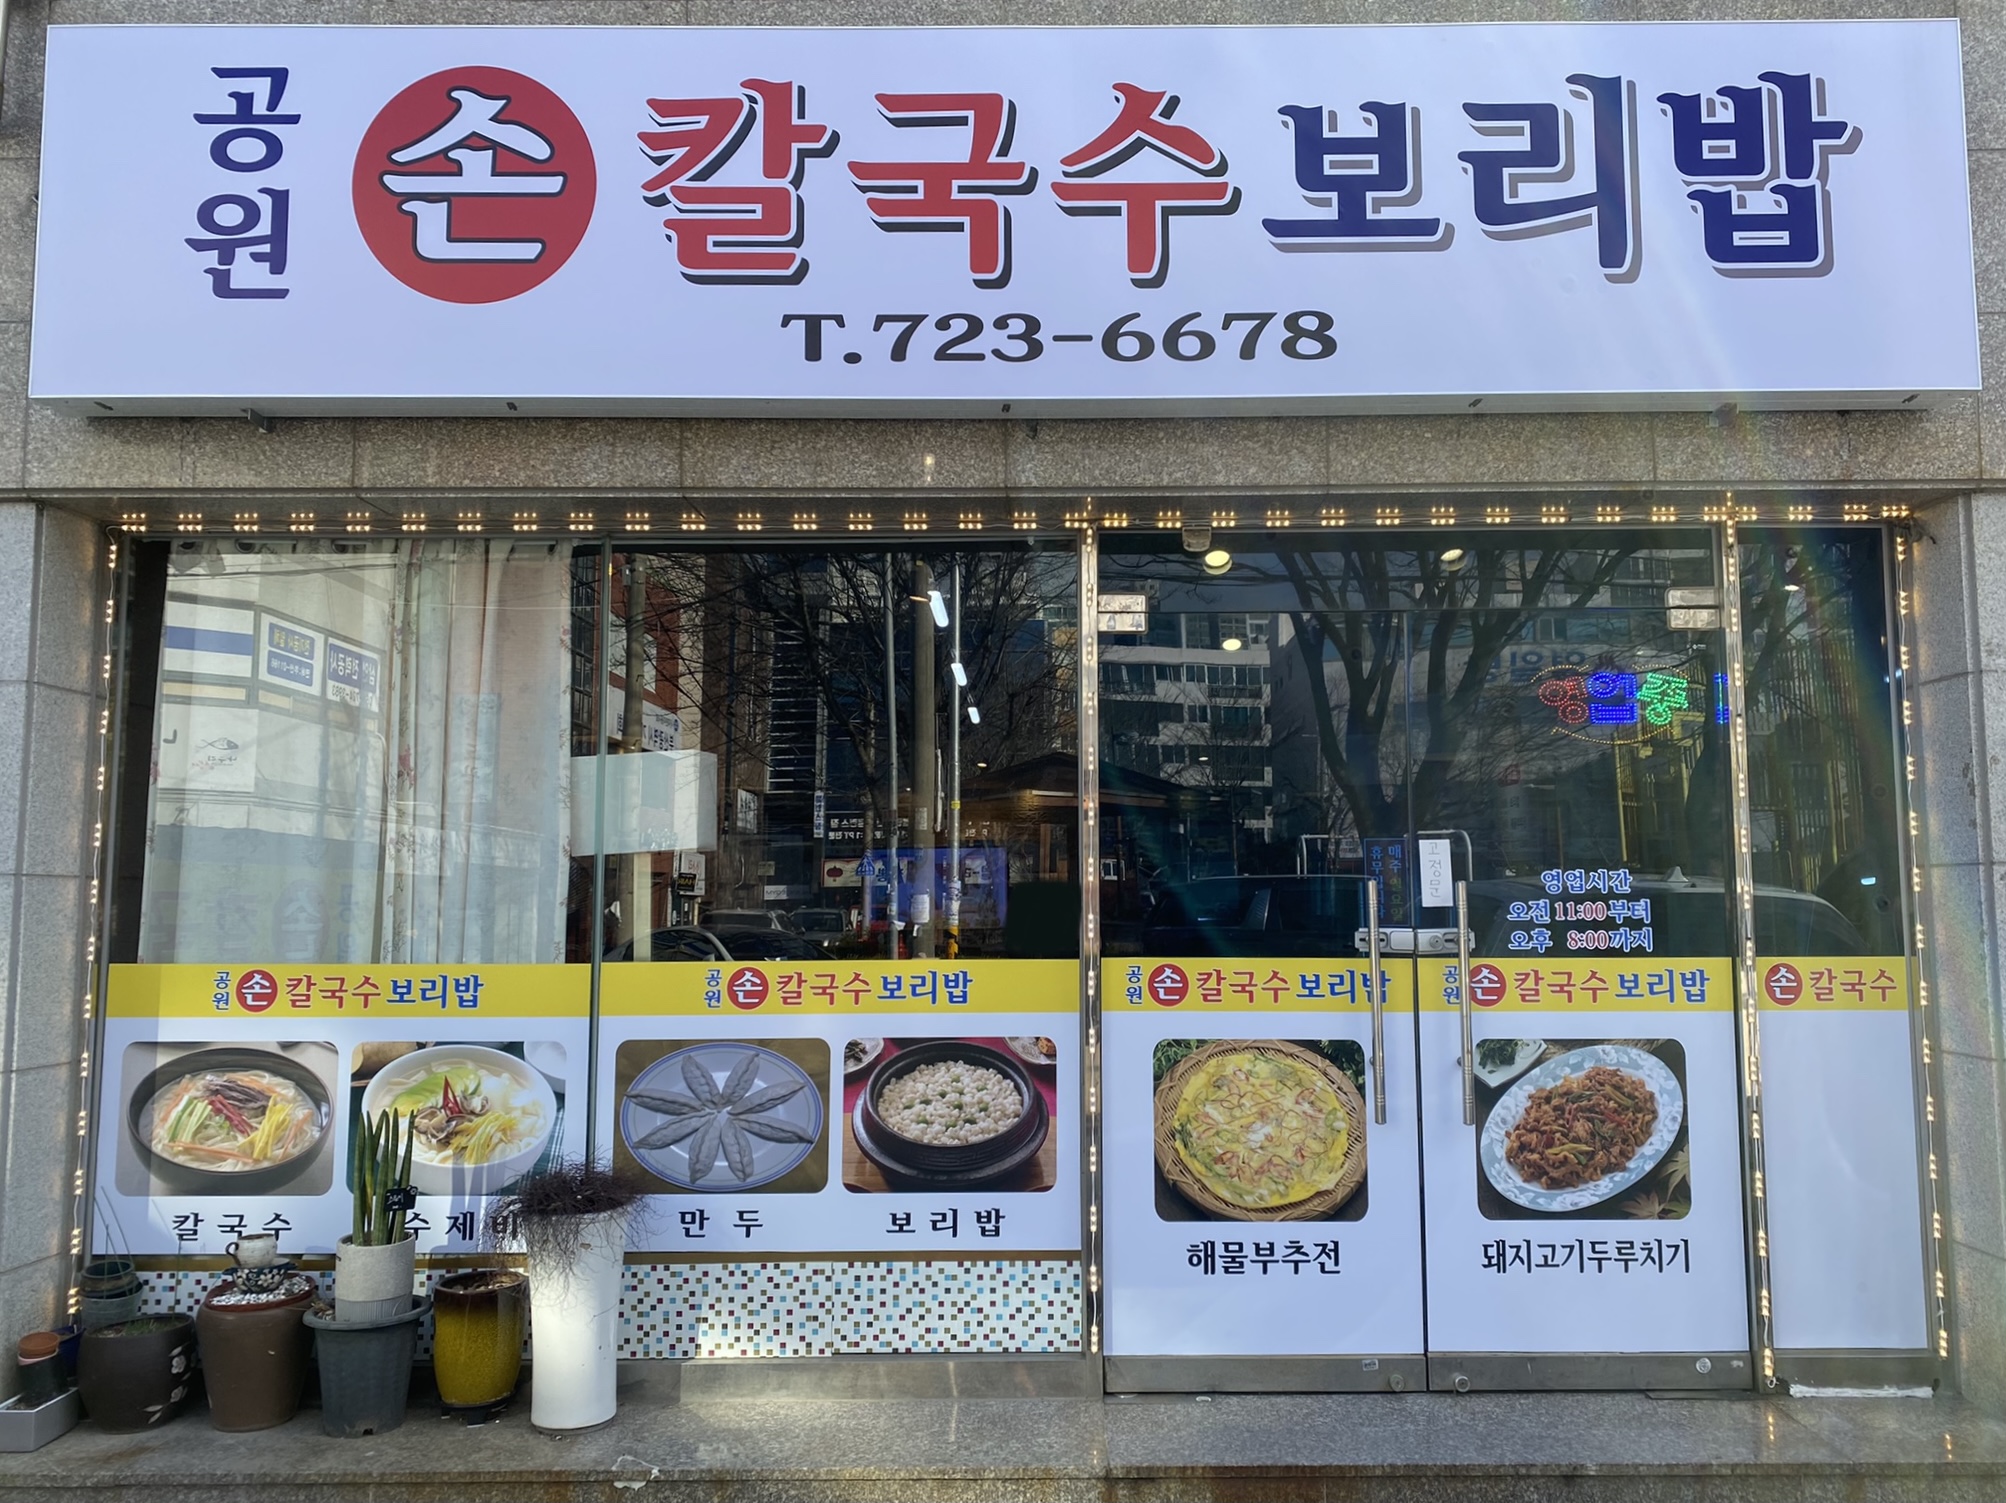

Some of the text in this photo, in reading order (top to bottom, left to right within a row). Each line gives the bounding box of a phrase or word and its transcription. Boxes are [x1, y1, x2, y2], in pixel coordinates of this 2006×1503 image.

[184, 66, 302, 299] 공원
[379, 86, 567, 264] 손
[781, 313, 1337, 363] T.723-6678
[1538, 671, 1690, 726] 영업중
[1427, 841, 1442, 898] 고정문
[1541, 869, 1633, 893] 영업시간
[1507, 900, 1551, 924] 오전
[1508, 928, 1554, 953] 오후
[240, 972, 278, 1009] 손
[732, 970, 765, 1006] 손
[1152, 967, 1184, 1001] 손
[1470, 967, 1503, 1003] 손
[1769, 966, 1799, 1001] 손
[1186, 1240, 1342, 1276] 해물부추전
[1481, 1238, 1691, 1275] 돼지고기두루치기
